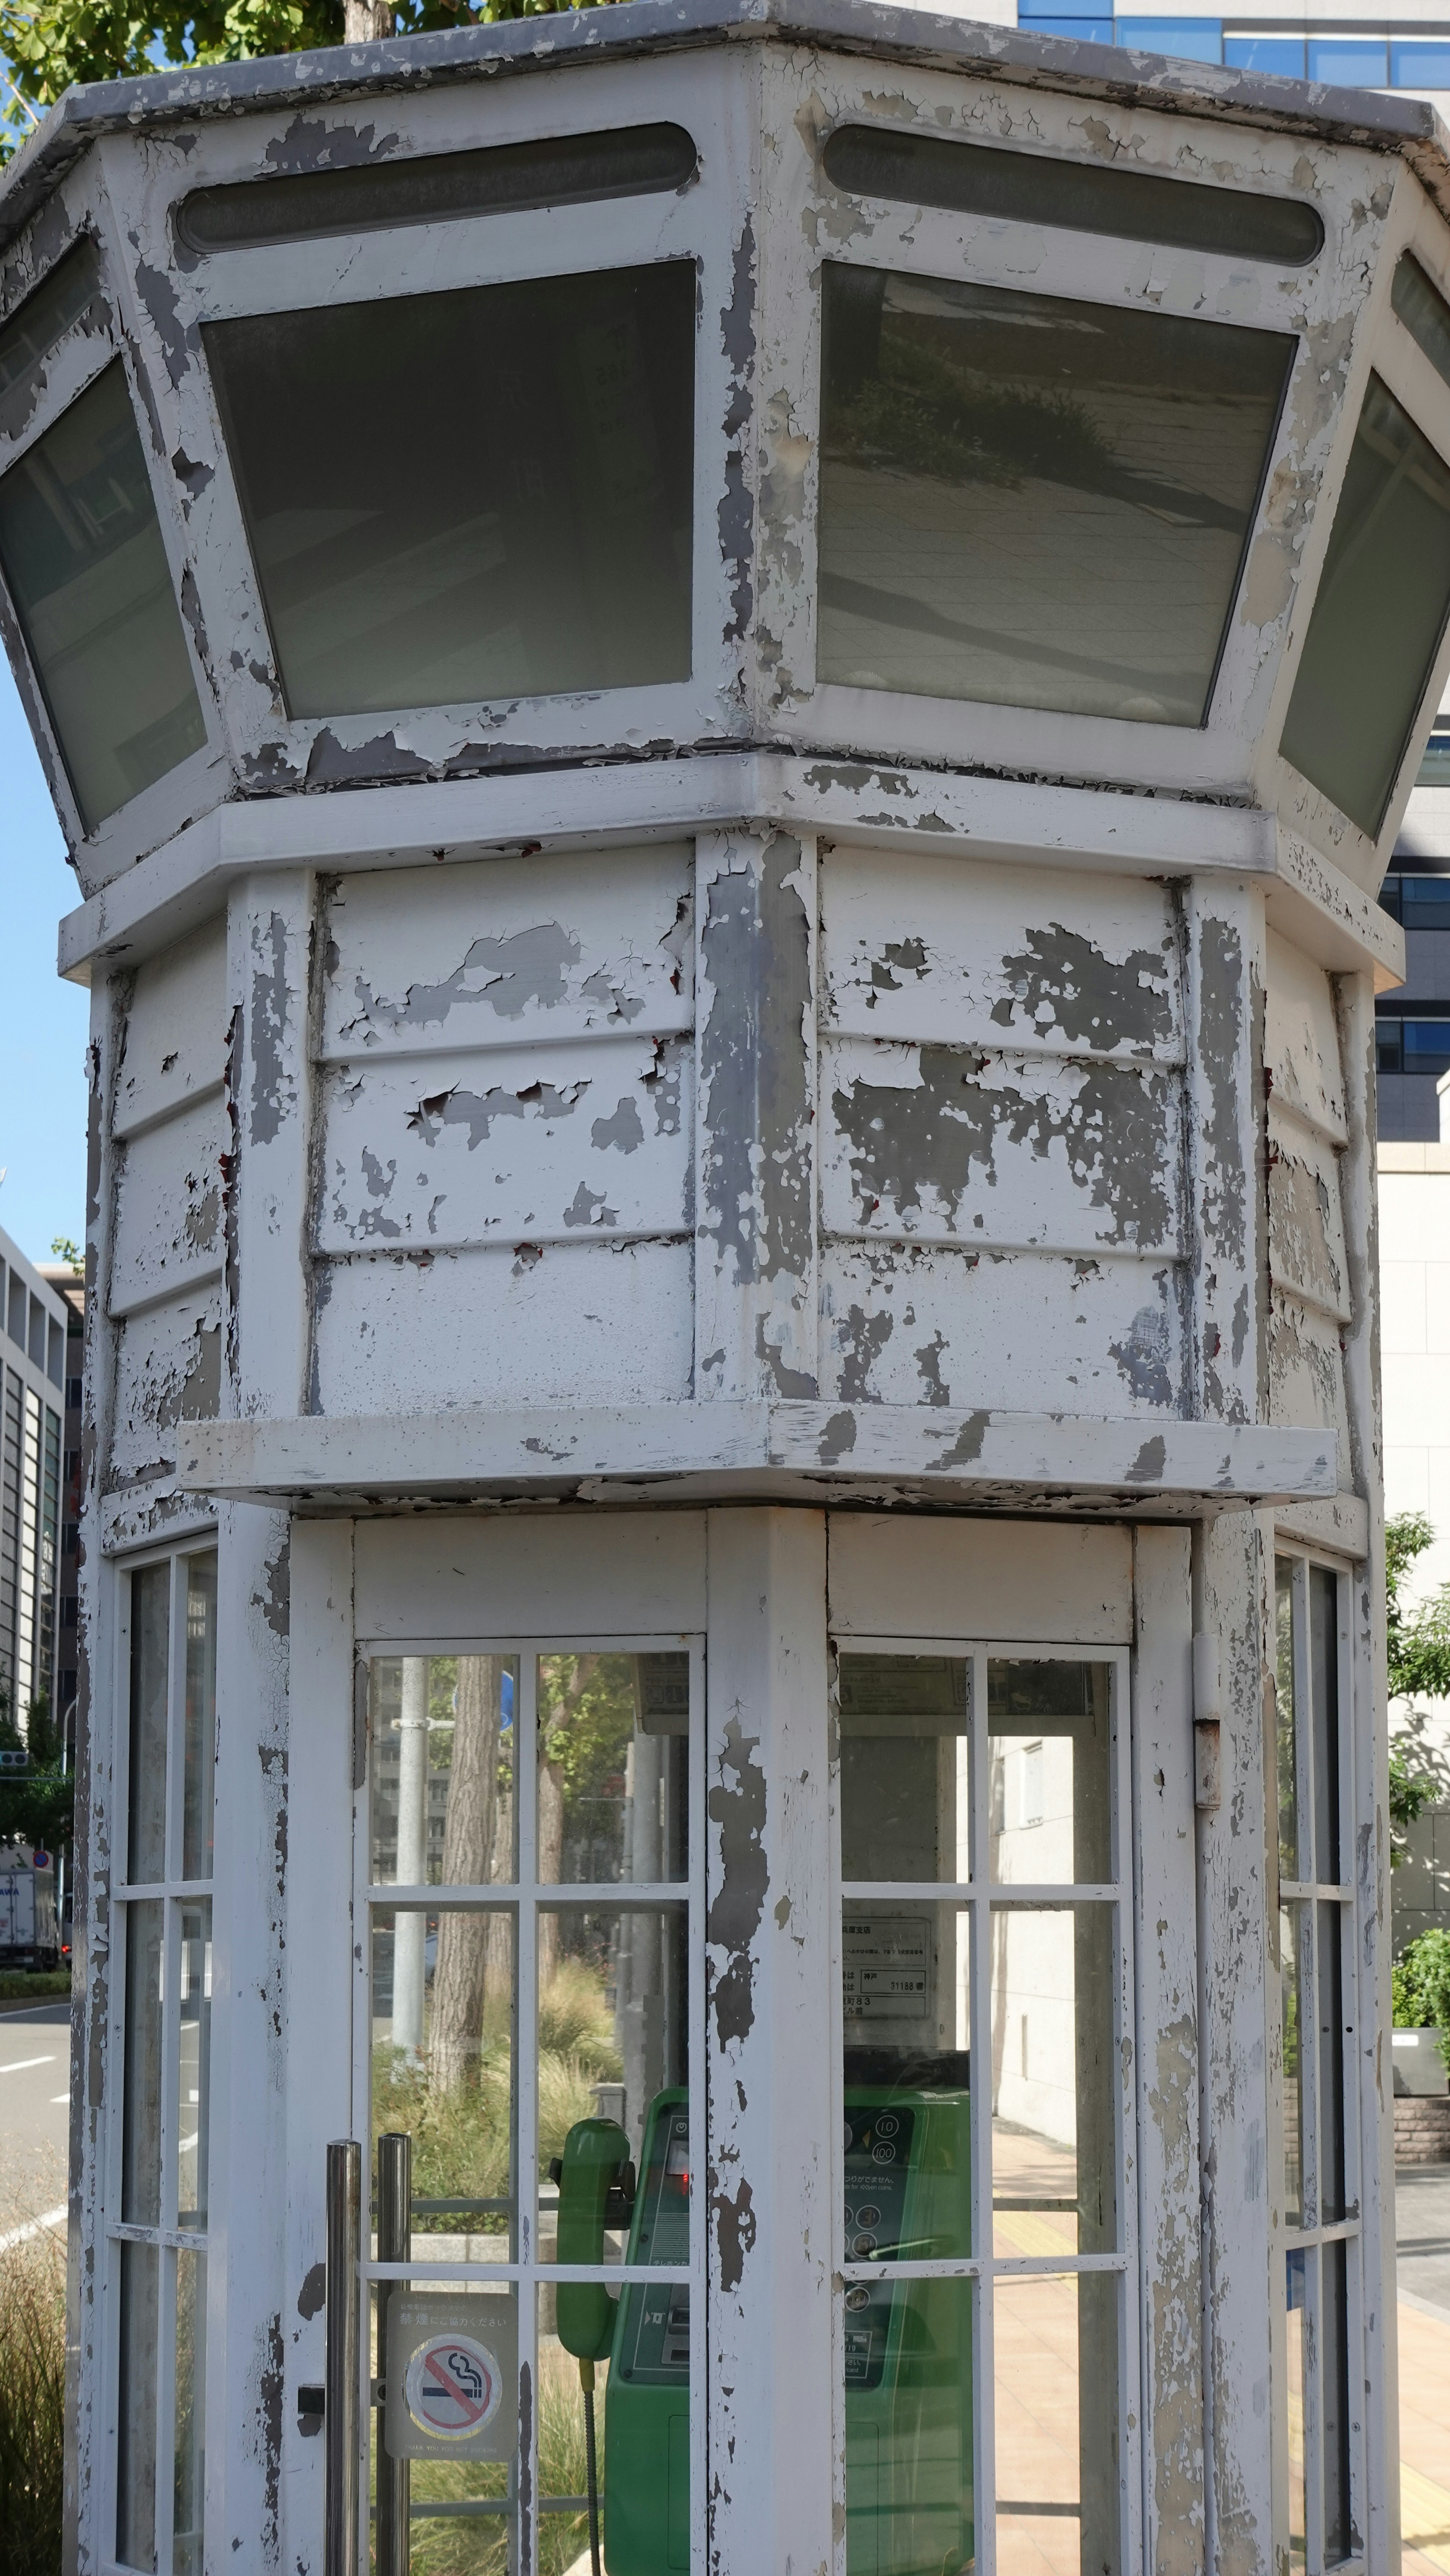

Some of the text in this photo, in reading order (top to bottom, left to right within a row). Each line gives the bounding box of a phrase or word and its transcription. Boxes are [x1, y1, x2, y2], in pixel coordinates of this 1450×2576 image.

[891, 1982, 924, 1990] 31188 番
[881, 2122, 893, 2131] 10
[876, 2147, 892, 2158] 100
